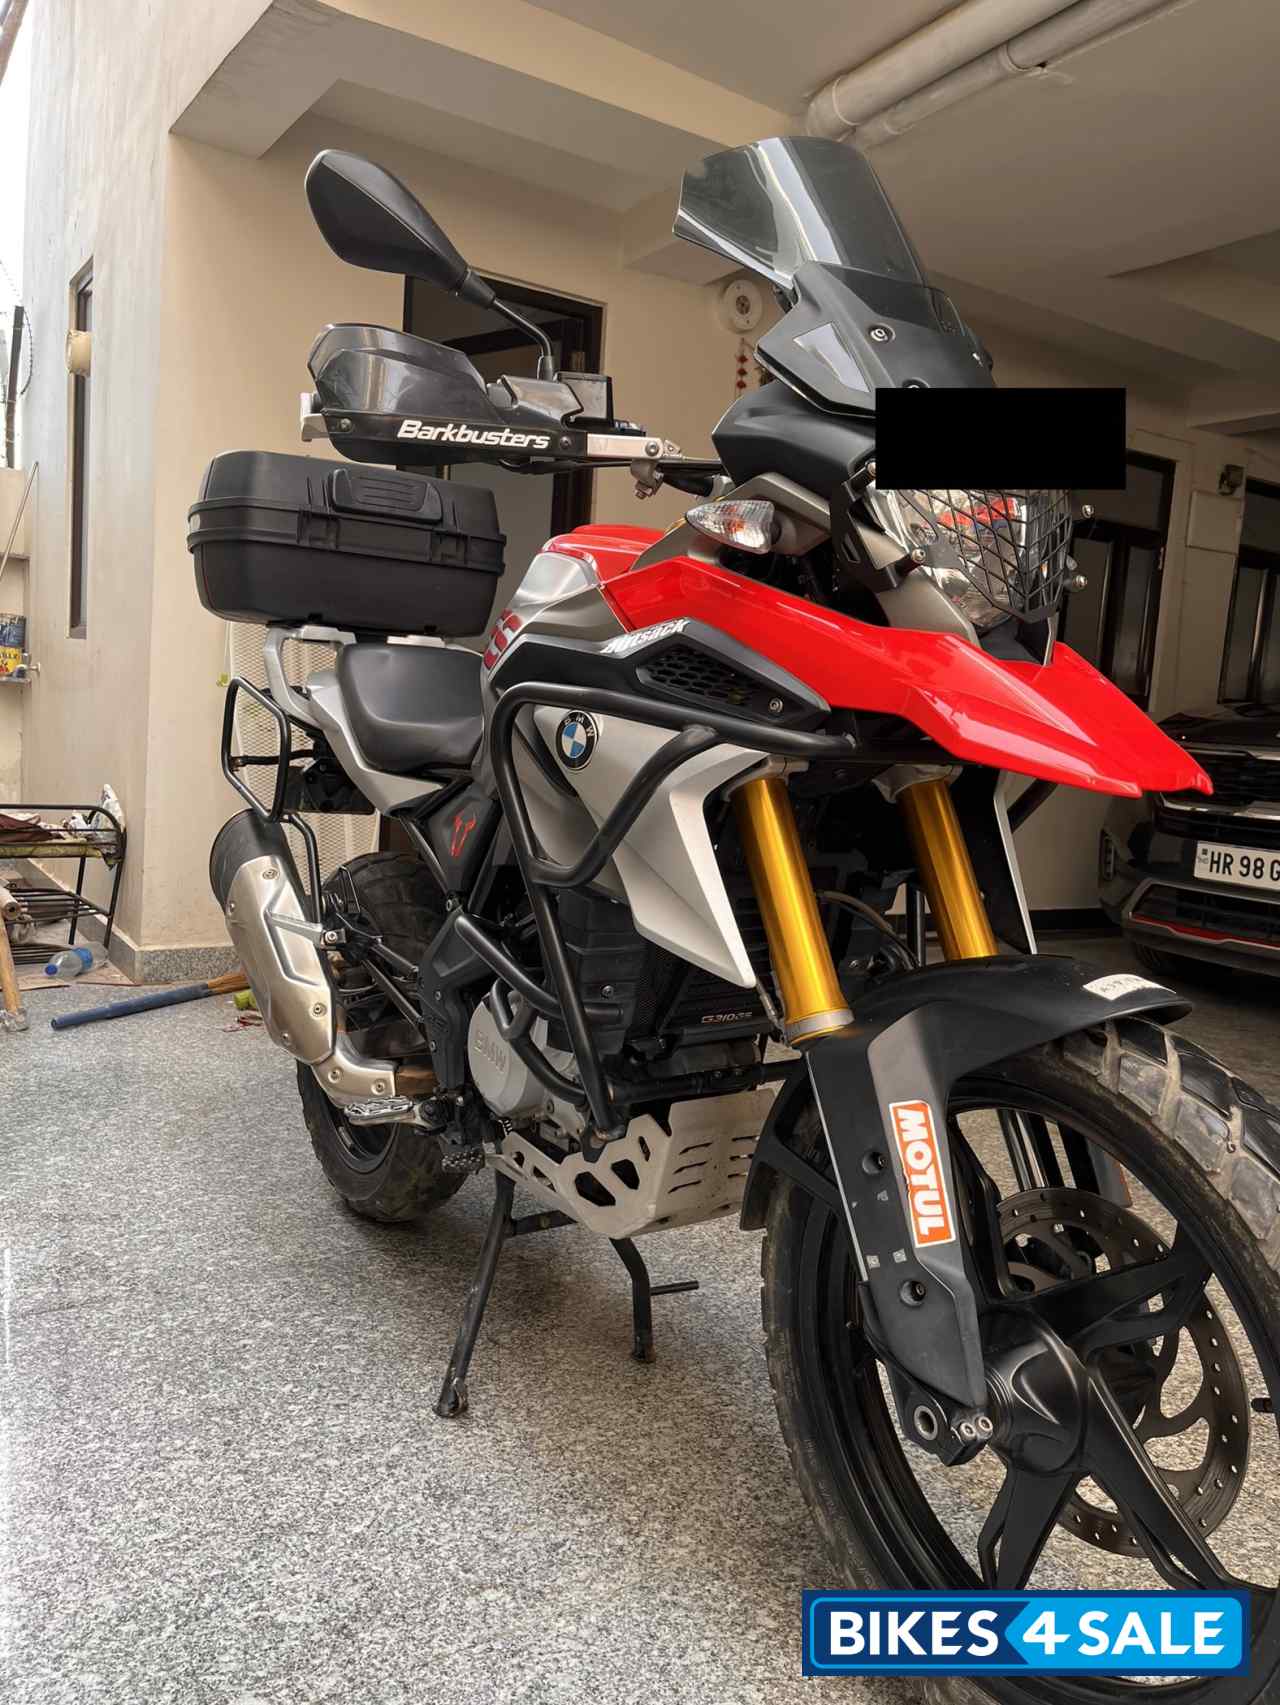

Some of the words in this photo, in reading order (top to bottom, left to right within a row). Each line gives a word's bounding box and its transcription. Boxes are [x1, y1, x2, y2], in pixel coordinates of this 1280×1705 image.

[397, 419, 550, 449] Barkbusters
[1209, 851, 1234, 876] HR
[1239, 855, 1265, 879] 98
[897, 1108, 945, 1236] MOTUL
